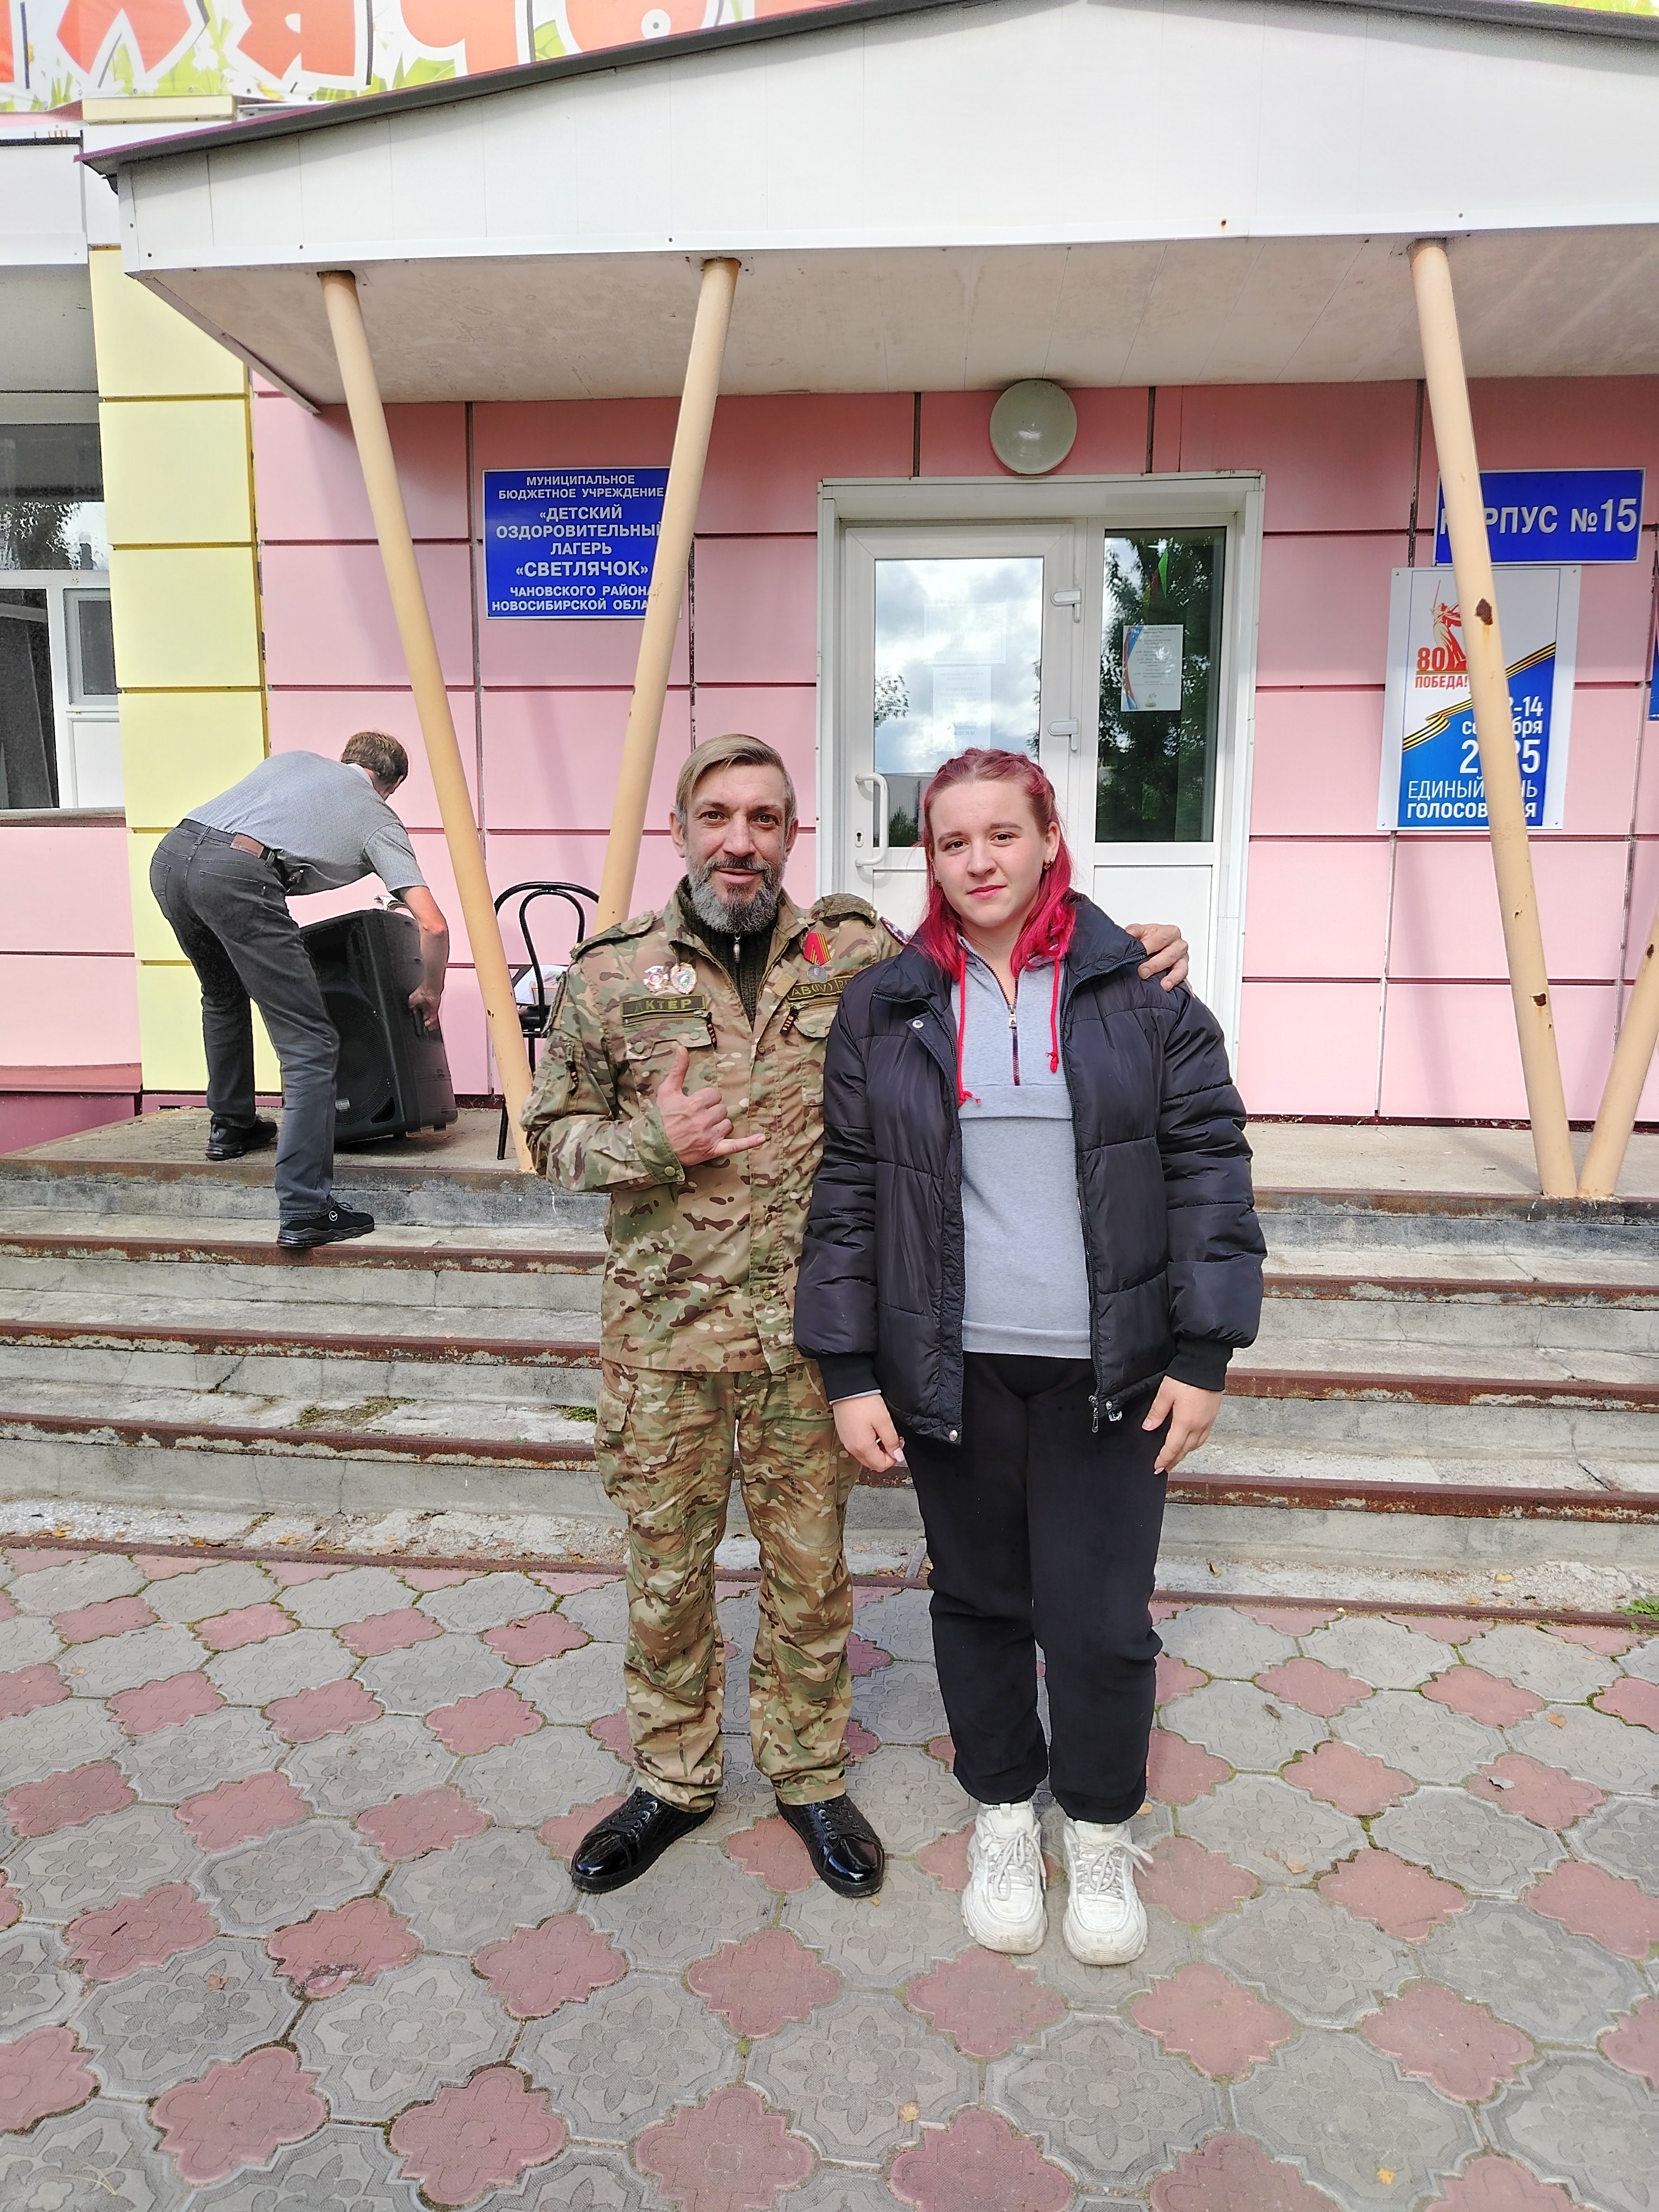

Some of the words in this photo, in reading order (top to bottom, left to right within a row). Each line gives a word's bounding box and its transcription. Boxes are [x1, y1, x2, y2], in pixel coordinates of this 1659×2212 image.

[526, 475, 635, 486] МУНИЦИПАЛЬНОЕ
[499, 489, 576, 500] БЮДЖЕТНОЕ
[582, 488, 664, 498] УЧРЕЖДЕНИЕ
[540, 504, 622, 521] «ДЕТСКИЙ
[1440, 505, 1558, 534] РПУС
[550, 542, 612, 555] ЛАГЕРЬ
[516, 561, 648, 577] «СВЕТЛЯЧОК»
[510, 586, 596, 597] ЧАНОВСКОГО
[492, 598, 606, 611] НОВОСИБИРСКОЙ
[613, 600, 648, 610] ОБЛА
[1417, 647, 1446, 671] 80
[1415, 676, 1468, 690] ПОБЕДА!
[1509, 696, 1544, 717] -14
[1459, 739, 1541, 774] 25
[1408, 776, 1484, 801] ЕДИНЫЙ
[1407, 802, 1536, 818] ГОЛОСОВЯ
[635, 998, 691, 1013] АКТЁР
